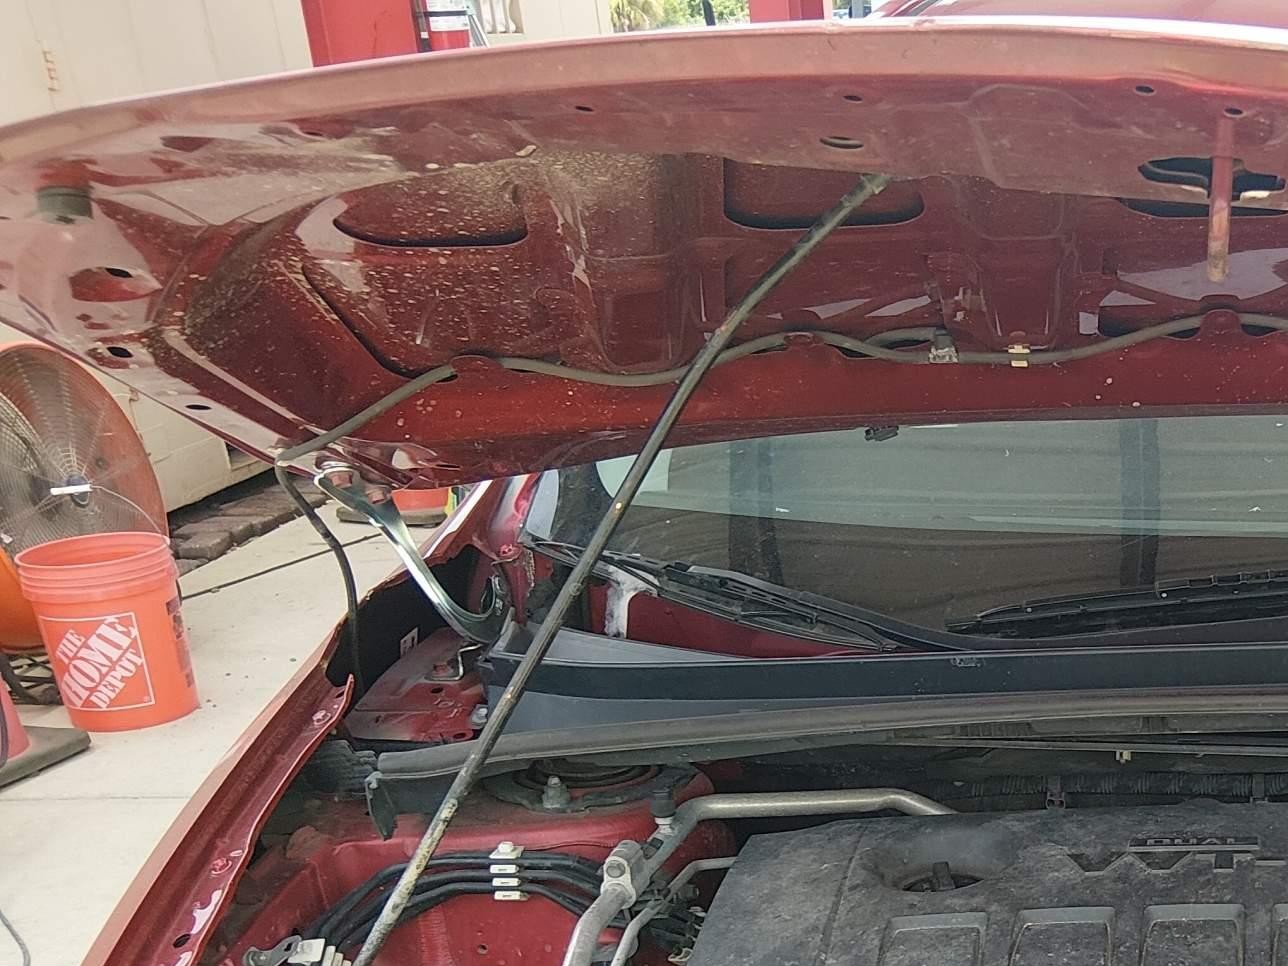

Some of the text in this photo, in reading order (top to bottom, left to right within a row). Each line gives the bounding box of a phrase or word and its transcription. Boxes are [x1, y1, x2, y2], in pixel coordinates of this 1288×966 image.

[55, 628, 86, 665] THE
[61, 616, 137, 708] HOME
[88, 648, 144, 709] DEPOT
